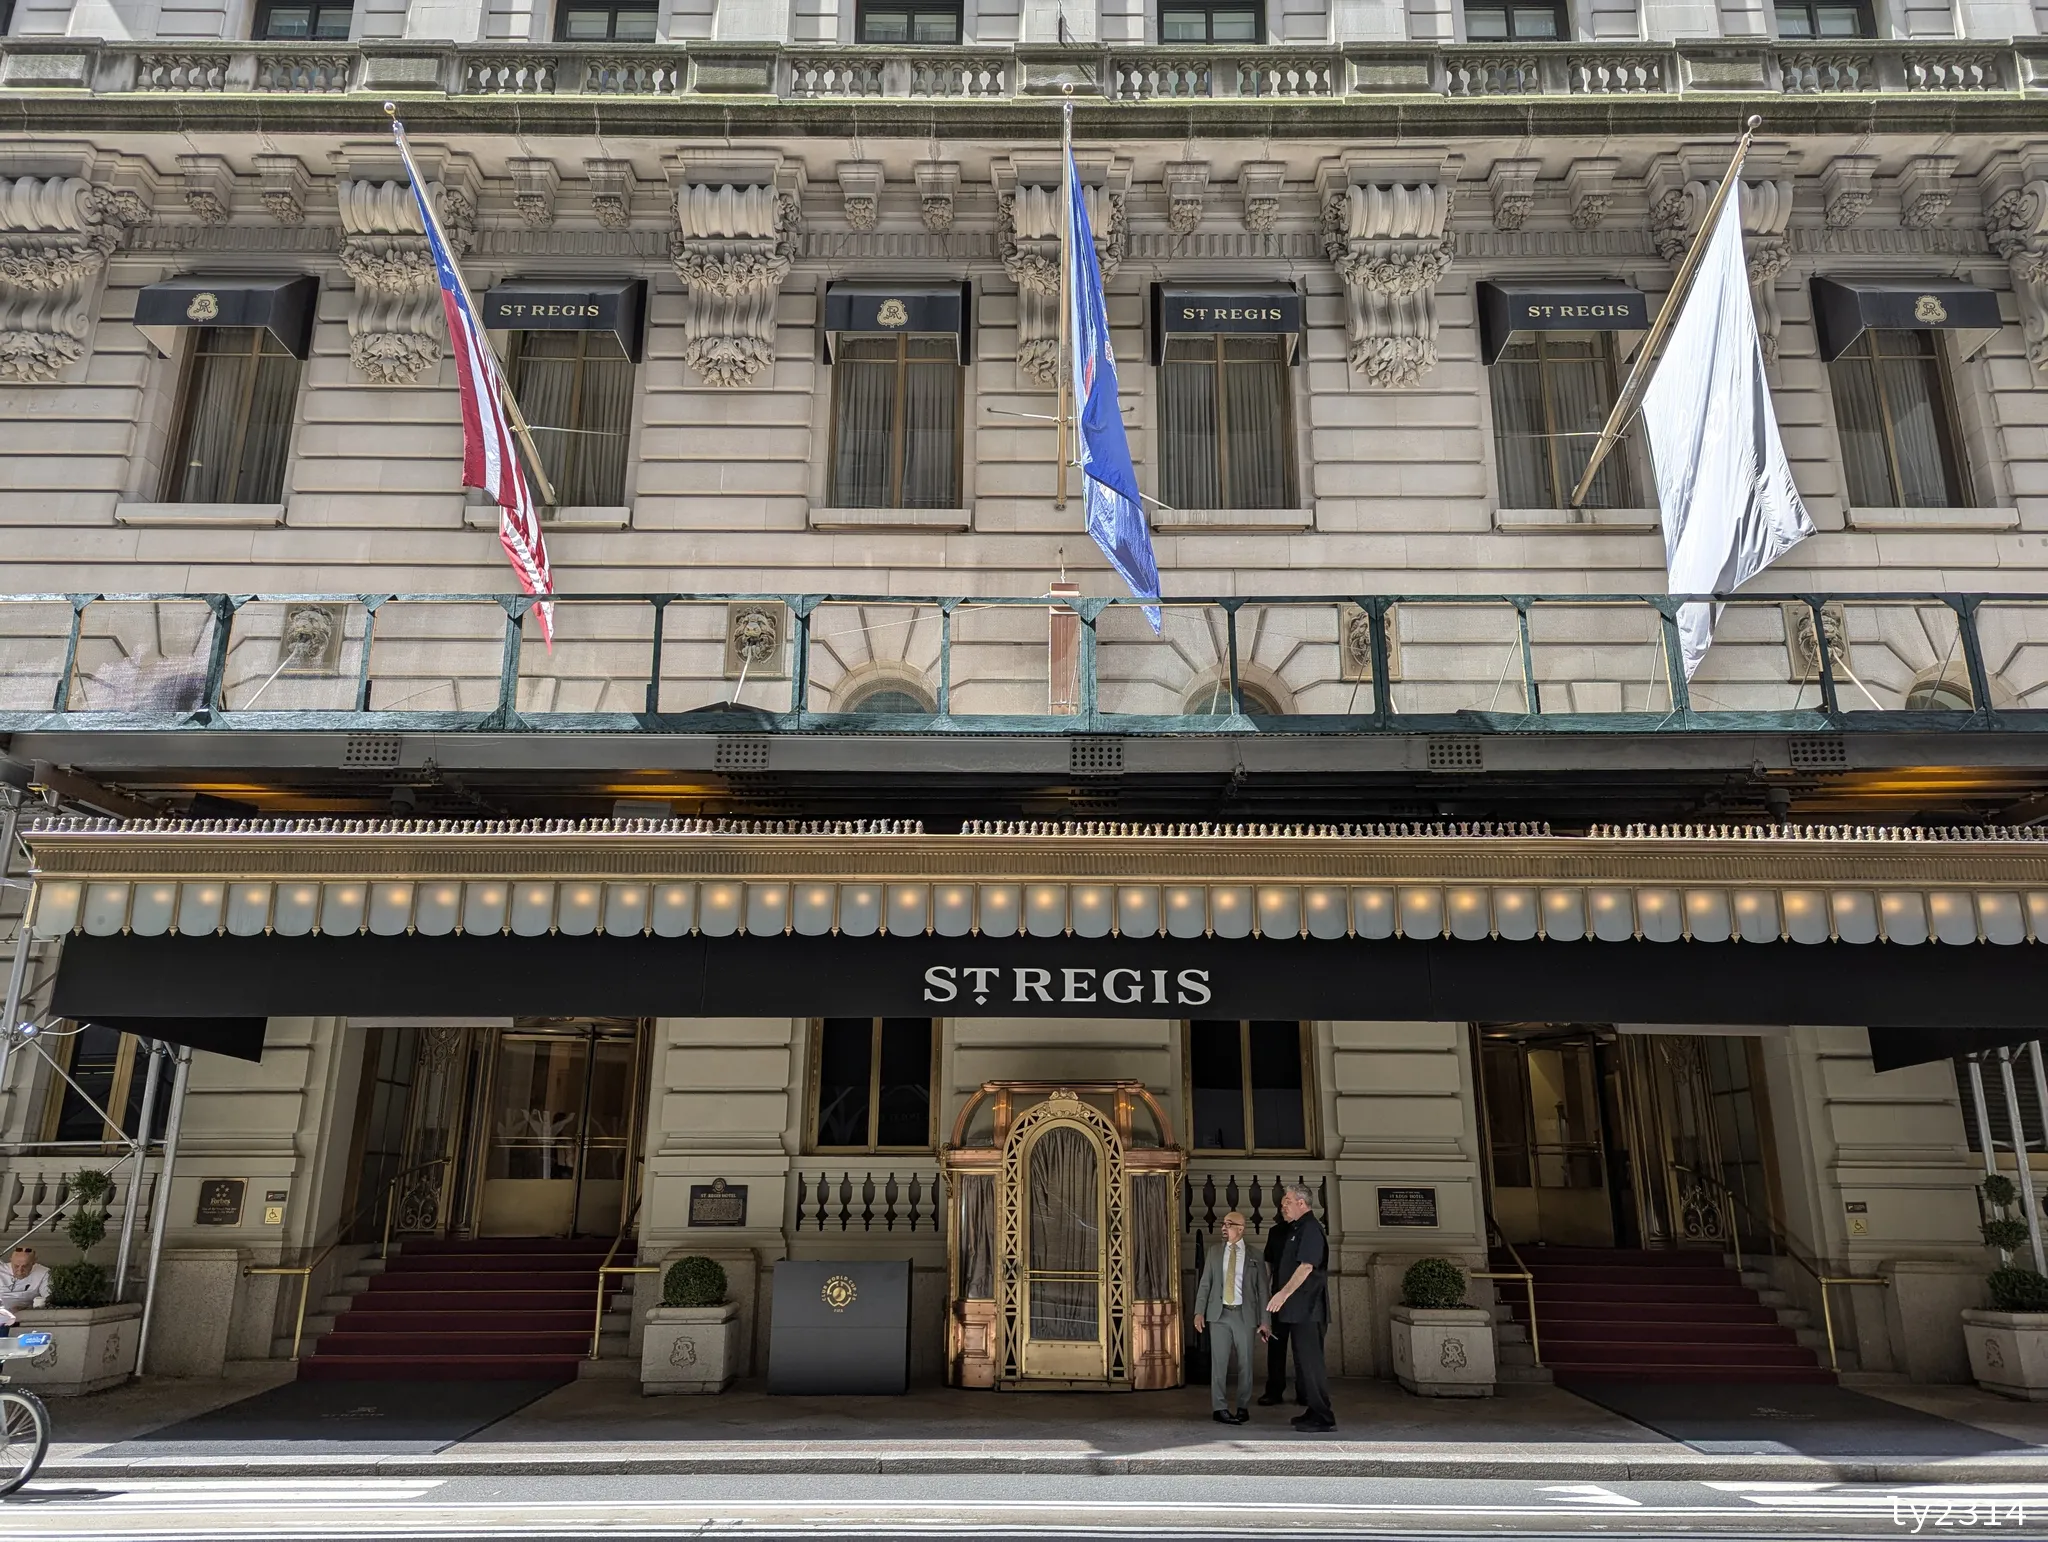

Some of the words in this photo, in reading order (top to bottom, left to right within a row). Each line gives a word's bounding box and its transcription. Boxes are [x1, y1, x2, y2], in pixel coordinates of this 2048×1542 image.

[531, 304, 599, 316] REGIS
[1214, 308, 1282, 320] REGIS
[1560, 304, 1630, 317] REGIS
[1012, 968, 1212, 1006] REGIS
